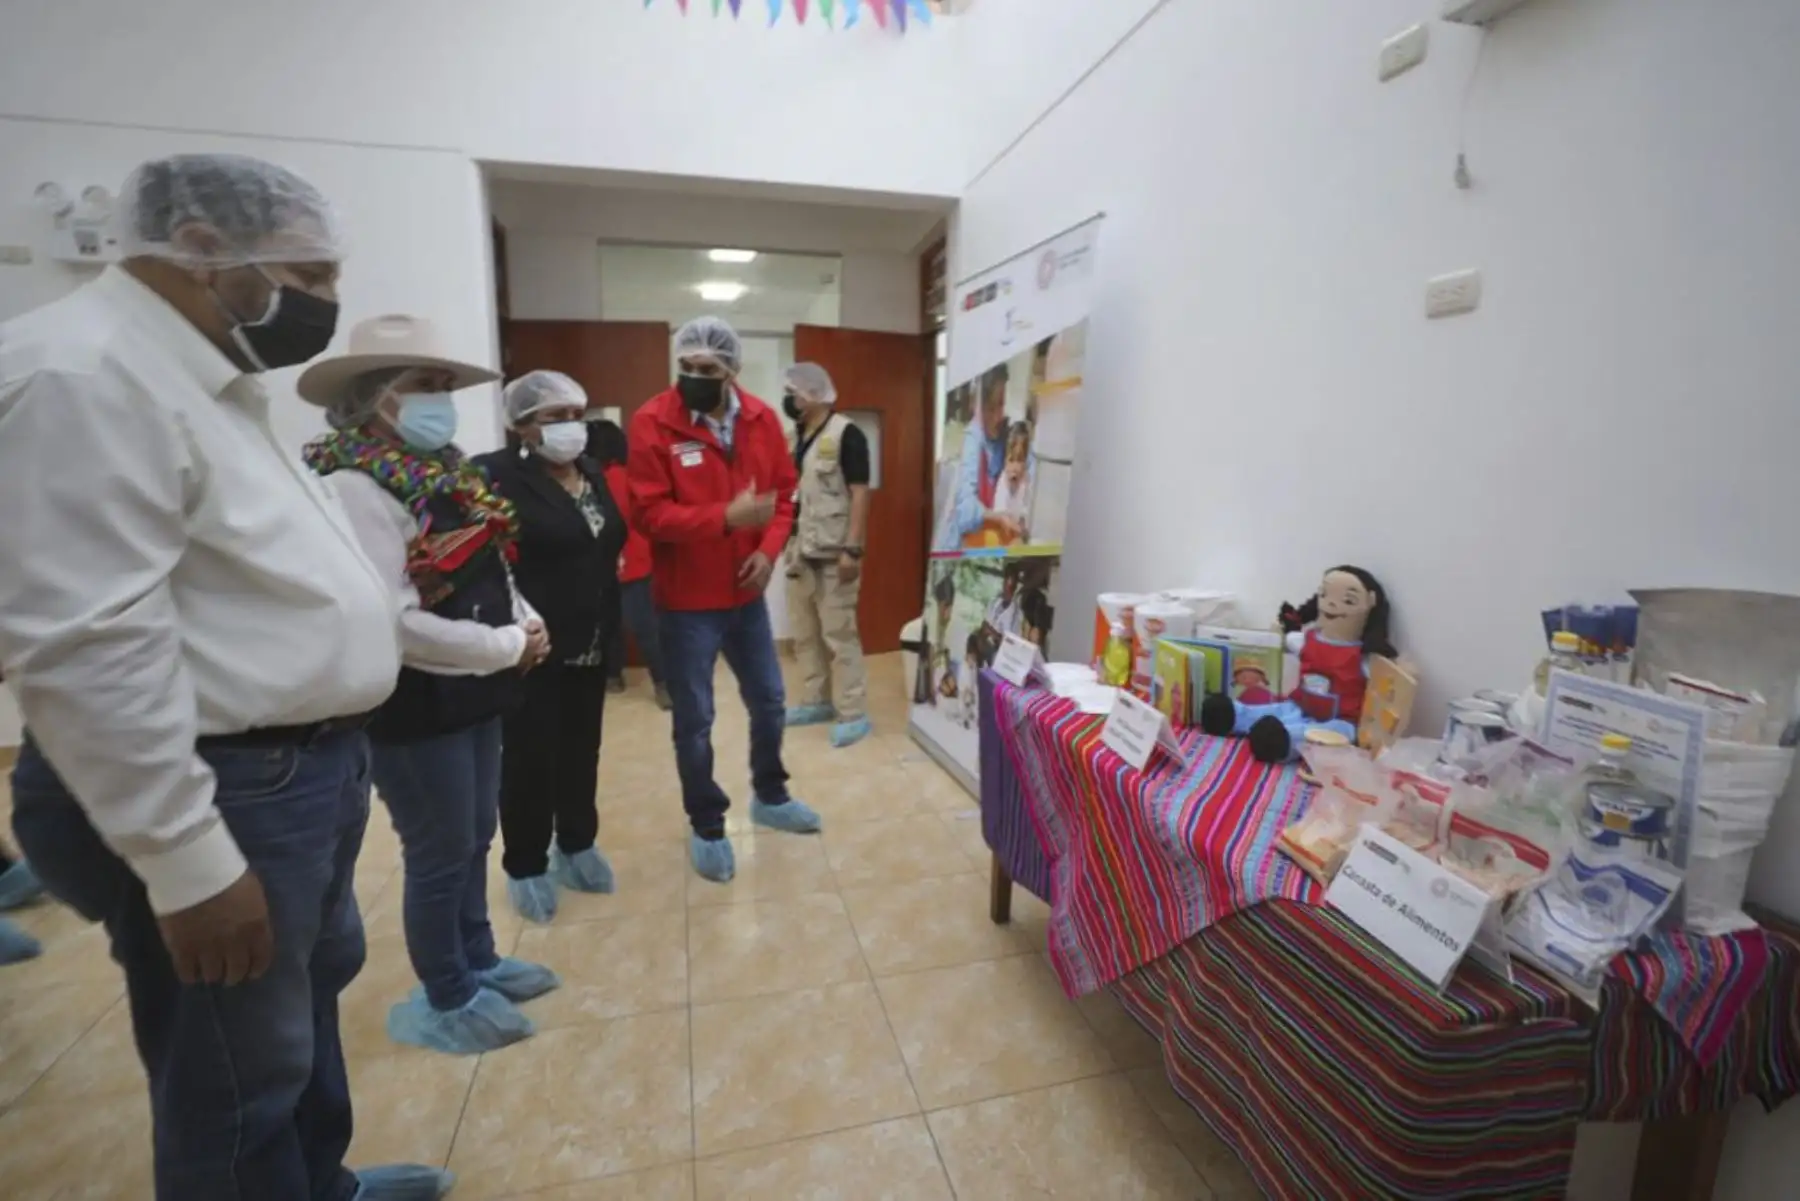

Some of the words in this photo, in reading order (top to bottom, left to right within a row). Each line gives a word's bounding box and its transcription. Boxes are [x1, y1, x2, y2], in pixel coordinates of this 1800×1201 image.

[1342, 864, 1382, 897] Canasta
[1382, 894, 1397, 909] de
[1398, 904, 1460, 952] Alimentos
